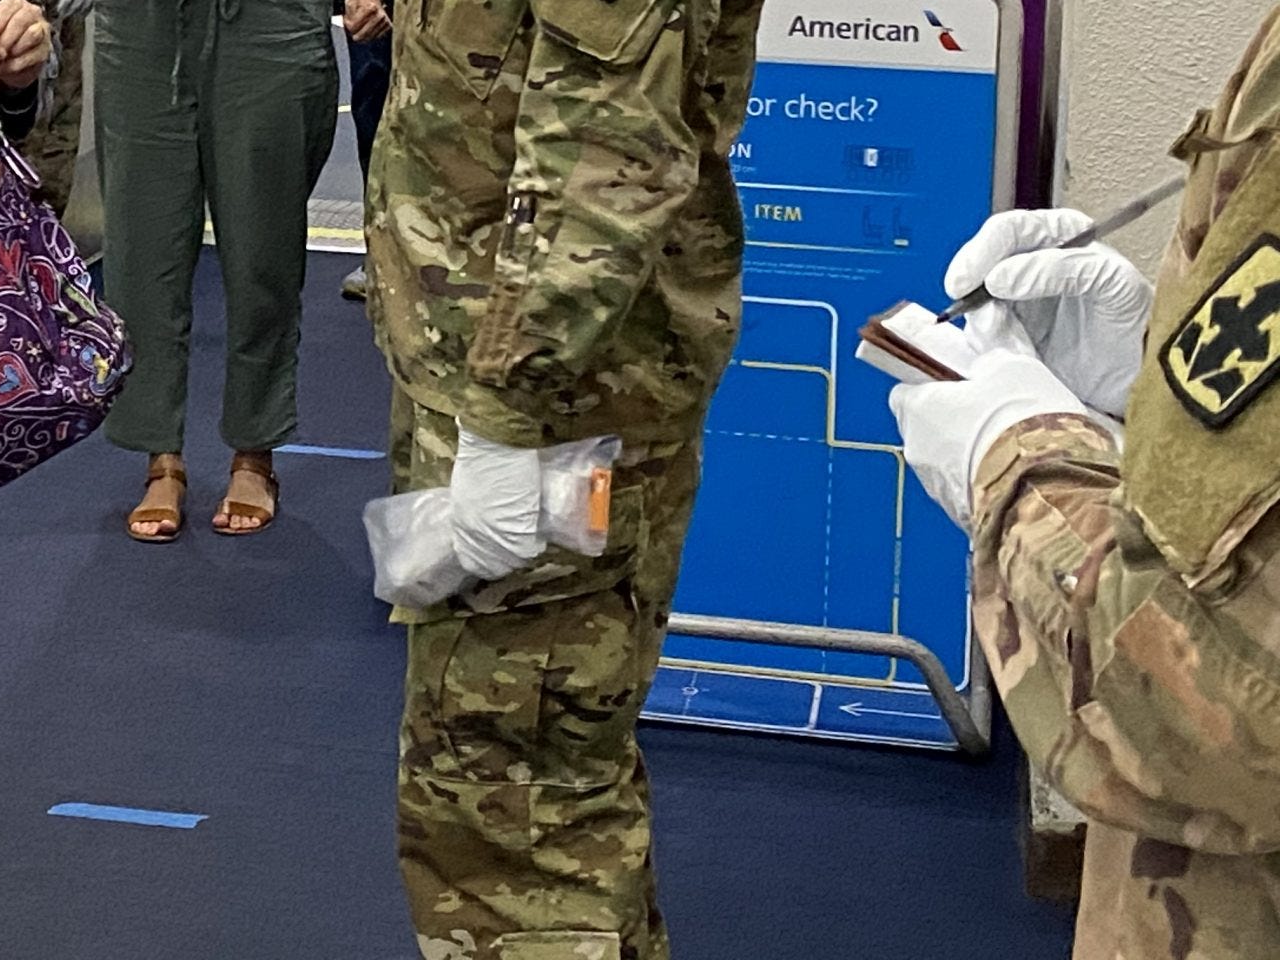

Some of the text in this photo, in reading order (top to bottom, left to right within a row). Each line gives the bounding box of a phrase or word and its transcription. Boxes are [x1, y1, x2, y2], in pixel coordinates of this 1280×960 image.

[788, 15, 920, 44] American
[746, 93, 879, 123] or check?
[753, 203, 803, 222] ITEM
